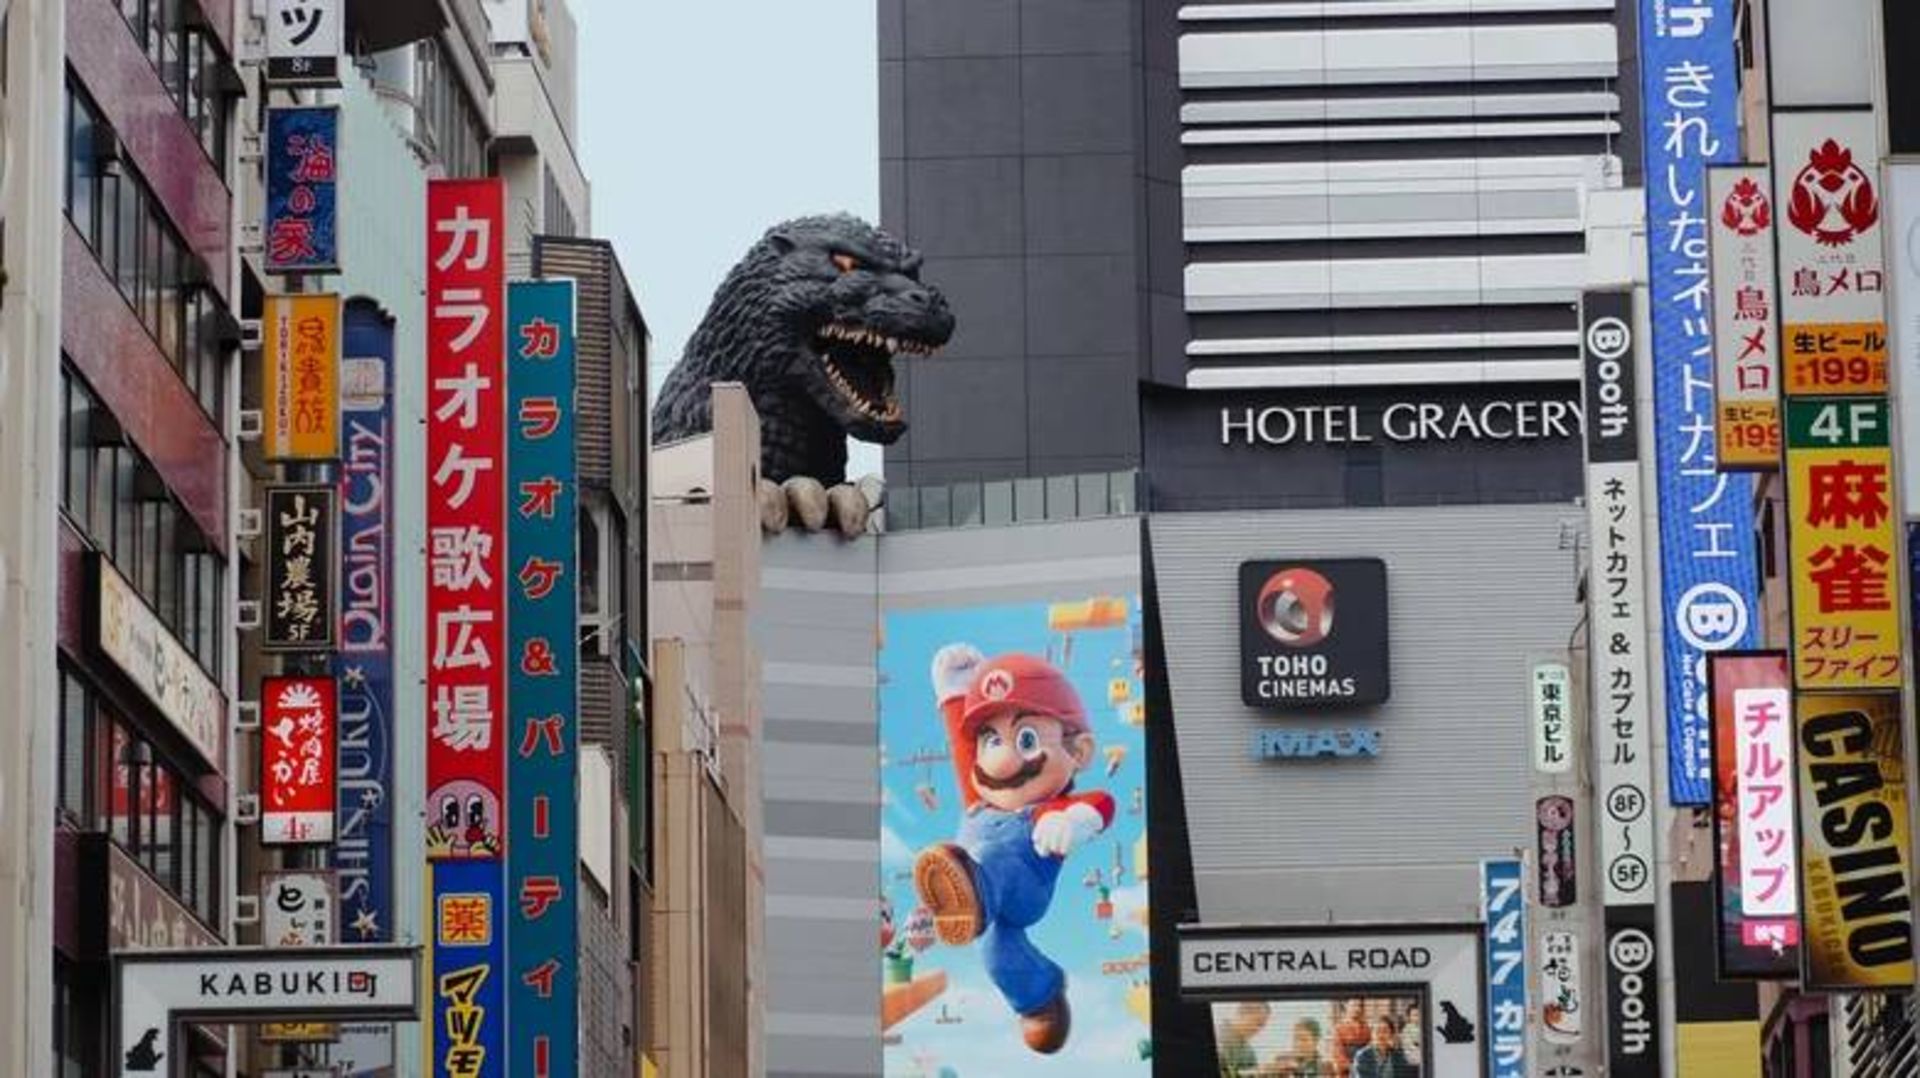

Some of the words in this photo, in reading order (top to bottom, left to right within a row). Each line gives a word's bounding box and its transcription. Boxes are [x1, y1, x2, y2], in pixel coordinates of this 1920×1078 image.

[1792, 267, 1882, 297] 鳥メロ
[1735, 285, 1770, 391] 鳥メロ
[1794, 331, 1885, 354] 生ビール
[1221, 407, 1372, 444] HOTEL
[1810, 404, 1877, 443] 4F
[431, 206, 493, 751] カラオケ歌広場
[1604, 478, 1630, 619] ネットカフェ
[1806, 460, 1890, 613] 麻雀
[277, 494, 321, 623] 山内農場
[288, 625, 311, 641] 5F
[1610, 632, 1630, 655] &
[1803, 626, 1878, 650] スリー
[1257, 655, 1327, 677] TOHO
[1258, 679, 1355, 698] CINEMAS
[1542, 683, 1564, 763] 東京ビル
[1611, 667, 1635, 765] カプセル
[1614, 795, 1637, 812] 8F
[1744, 701, 1788, 902] チルアップ
[282, 816, 315, 841] 4F
[1802, 710, 1913, 967] CASINO
[1616, 864, 1640, 883] 5F
[444, 899, 485, 938] 薬
[1490, 877, 1520, 985] 747
[1193, 951, 1336, 973] CENTRAL
[1348, 948, 1431, 969] ROAD
[1609, 929, 1654, 1055] Booth
[1493, 1000, 1525, 1078] カラ
